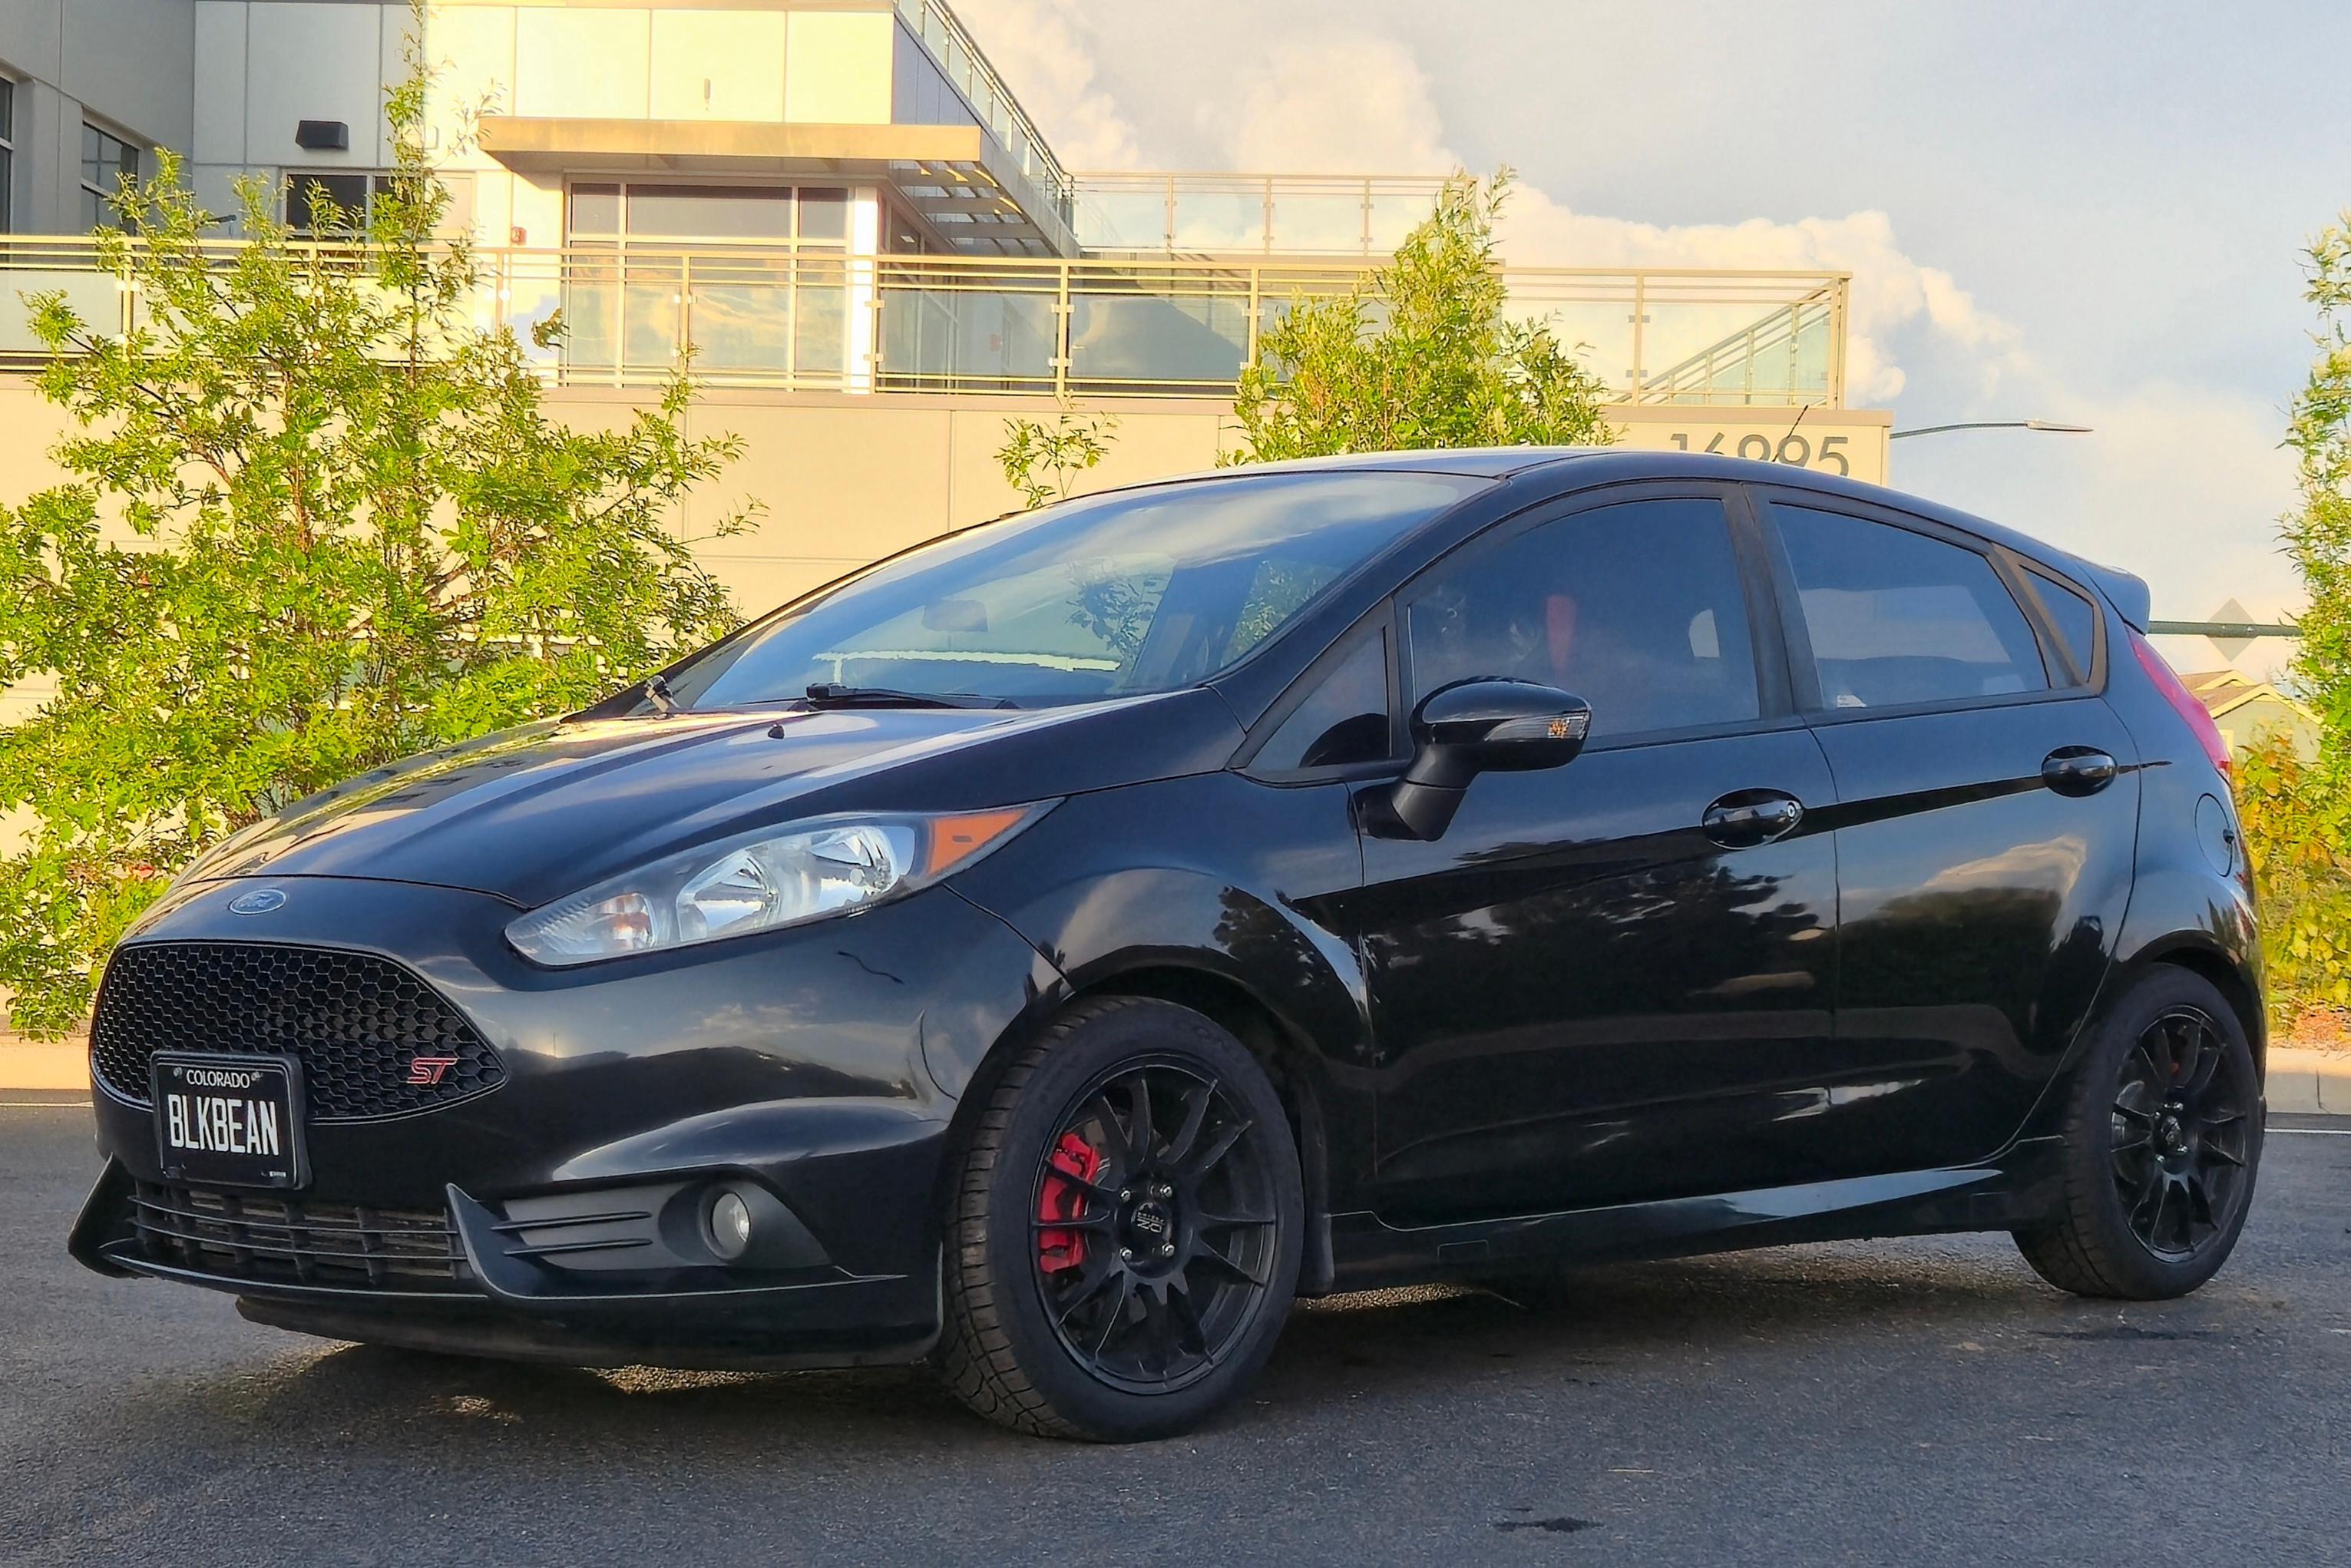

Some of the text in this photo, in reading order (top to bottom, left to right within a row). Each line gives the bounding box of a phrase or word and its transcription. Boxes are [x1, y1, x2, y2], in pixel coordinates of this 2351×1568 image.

[187, 1069, 250, 1089] COLORADO
[406, 1057, 458, 1084] ST
[167, 1093, 279, 1156] BLKBEAN
